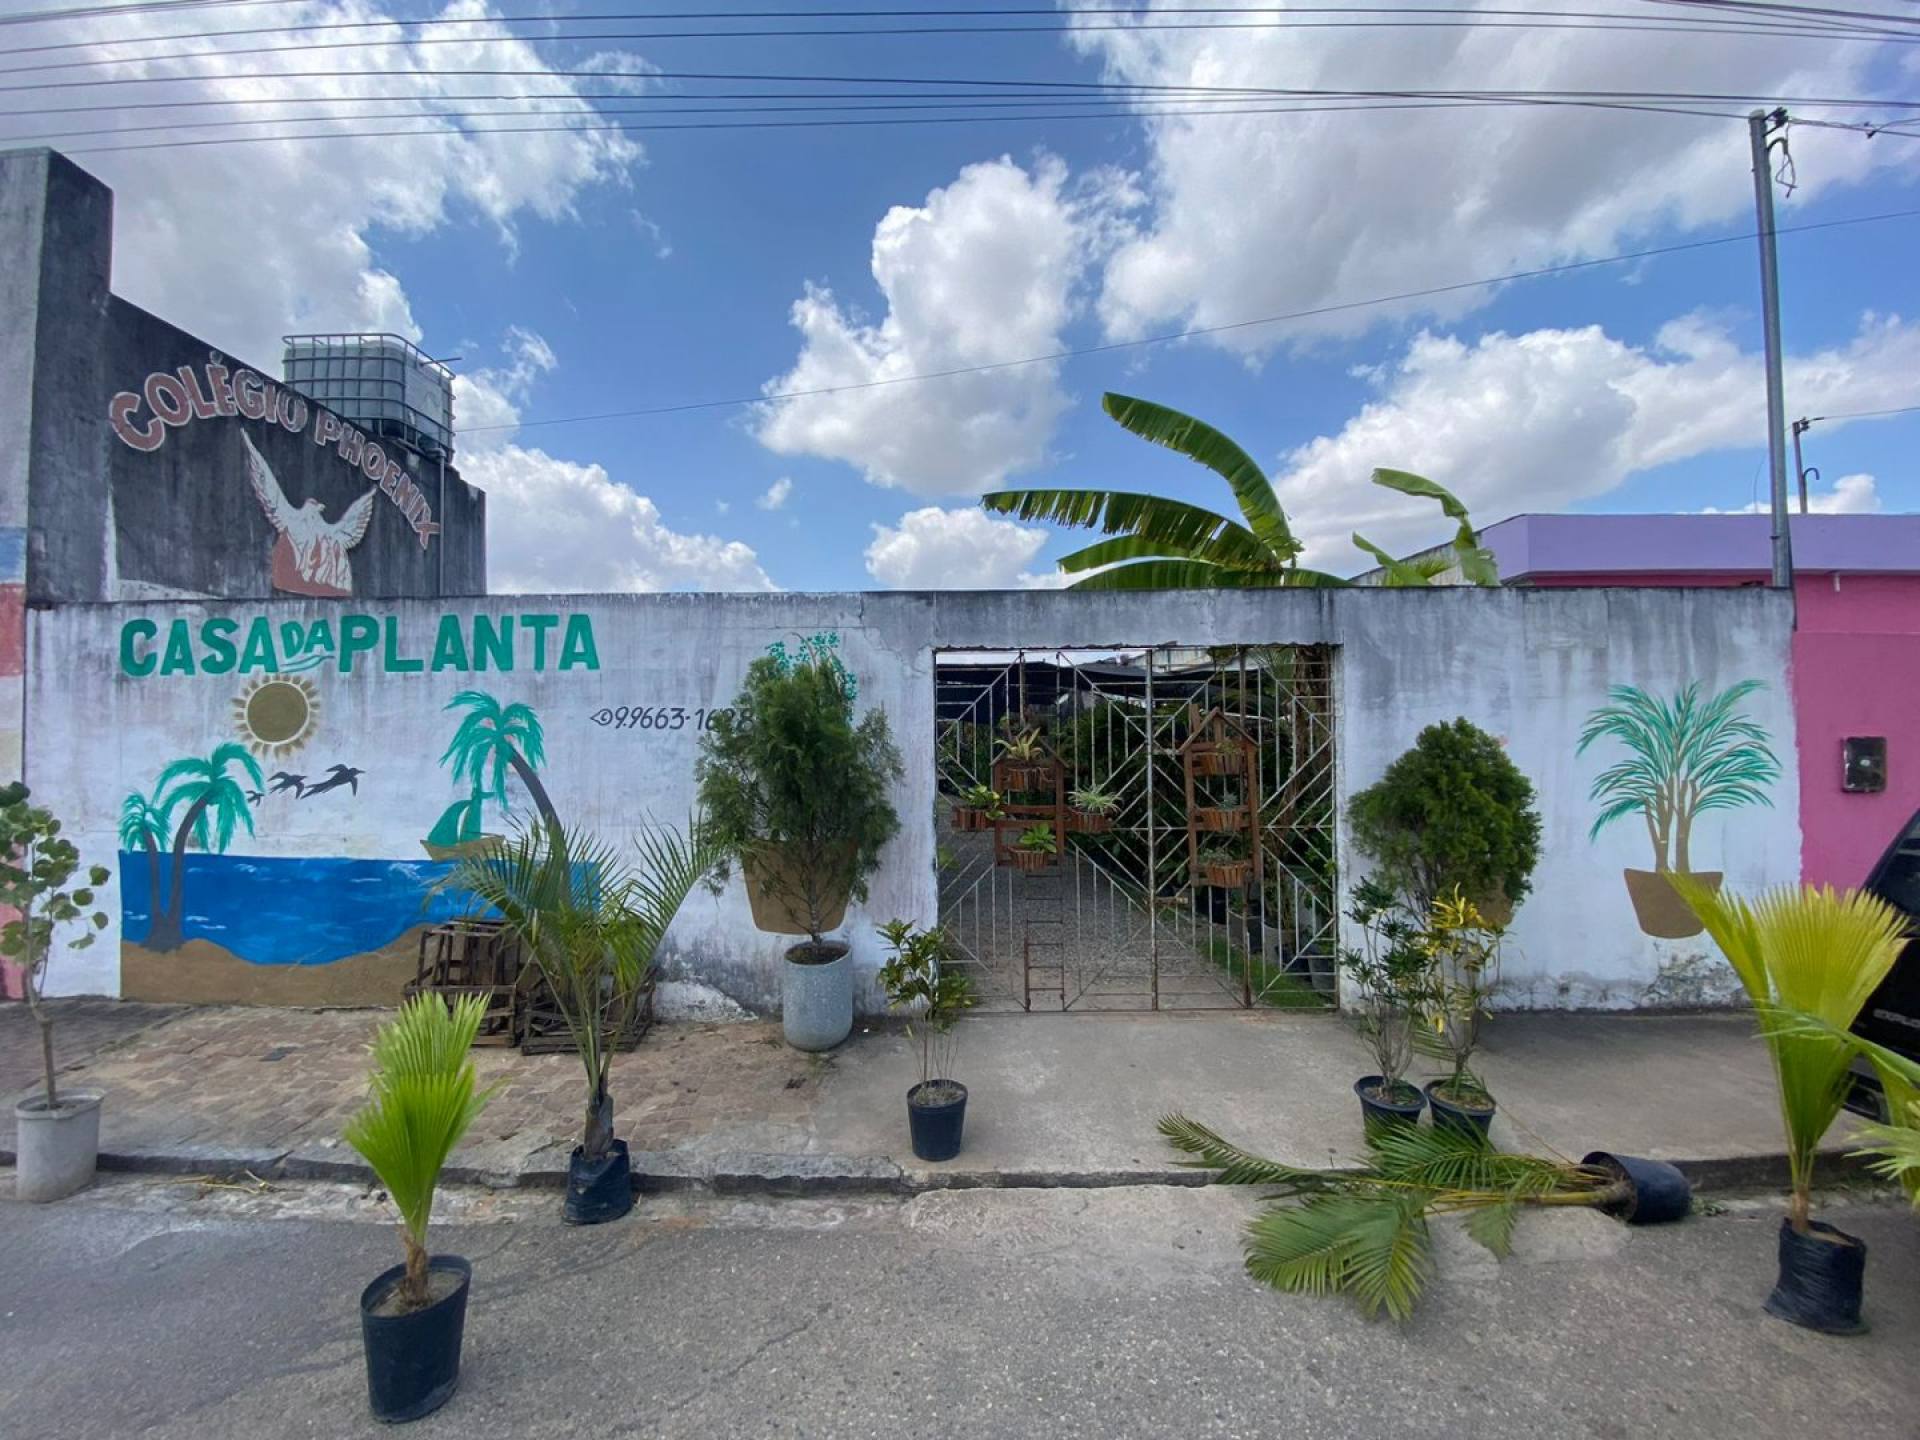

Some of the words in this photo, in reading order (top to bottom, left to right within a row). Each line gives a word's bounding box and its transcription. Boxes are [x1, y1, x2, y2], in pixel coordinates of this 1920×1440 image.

[109, 351, 308, 451] COLÉGIO
[315, 409, 441, 549] PHOENIX
[120, 617, 278, 676] CASA
[280, 619, 335, 659] DA
[338, 614, 599, 675] PLANTA
